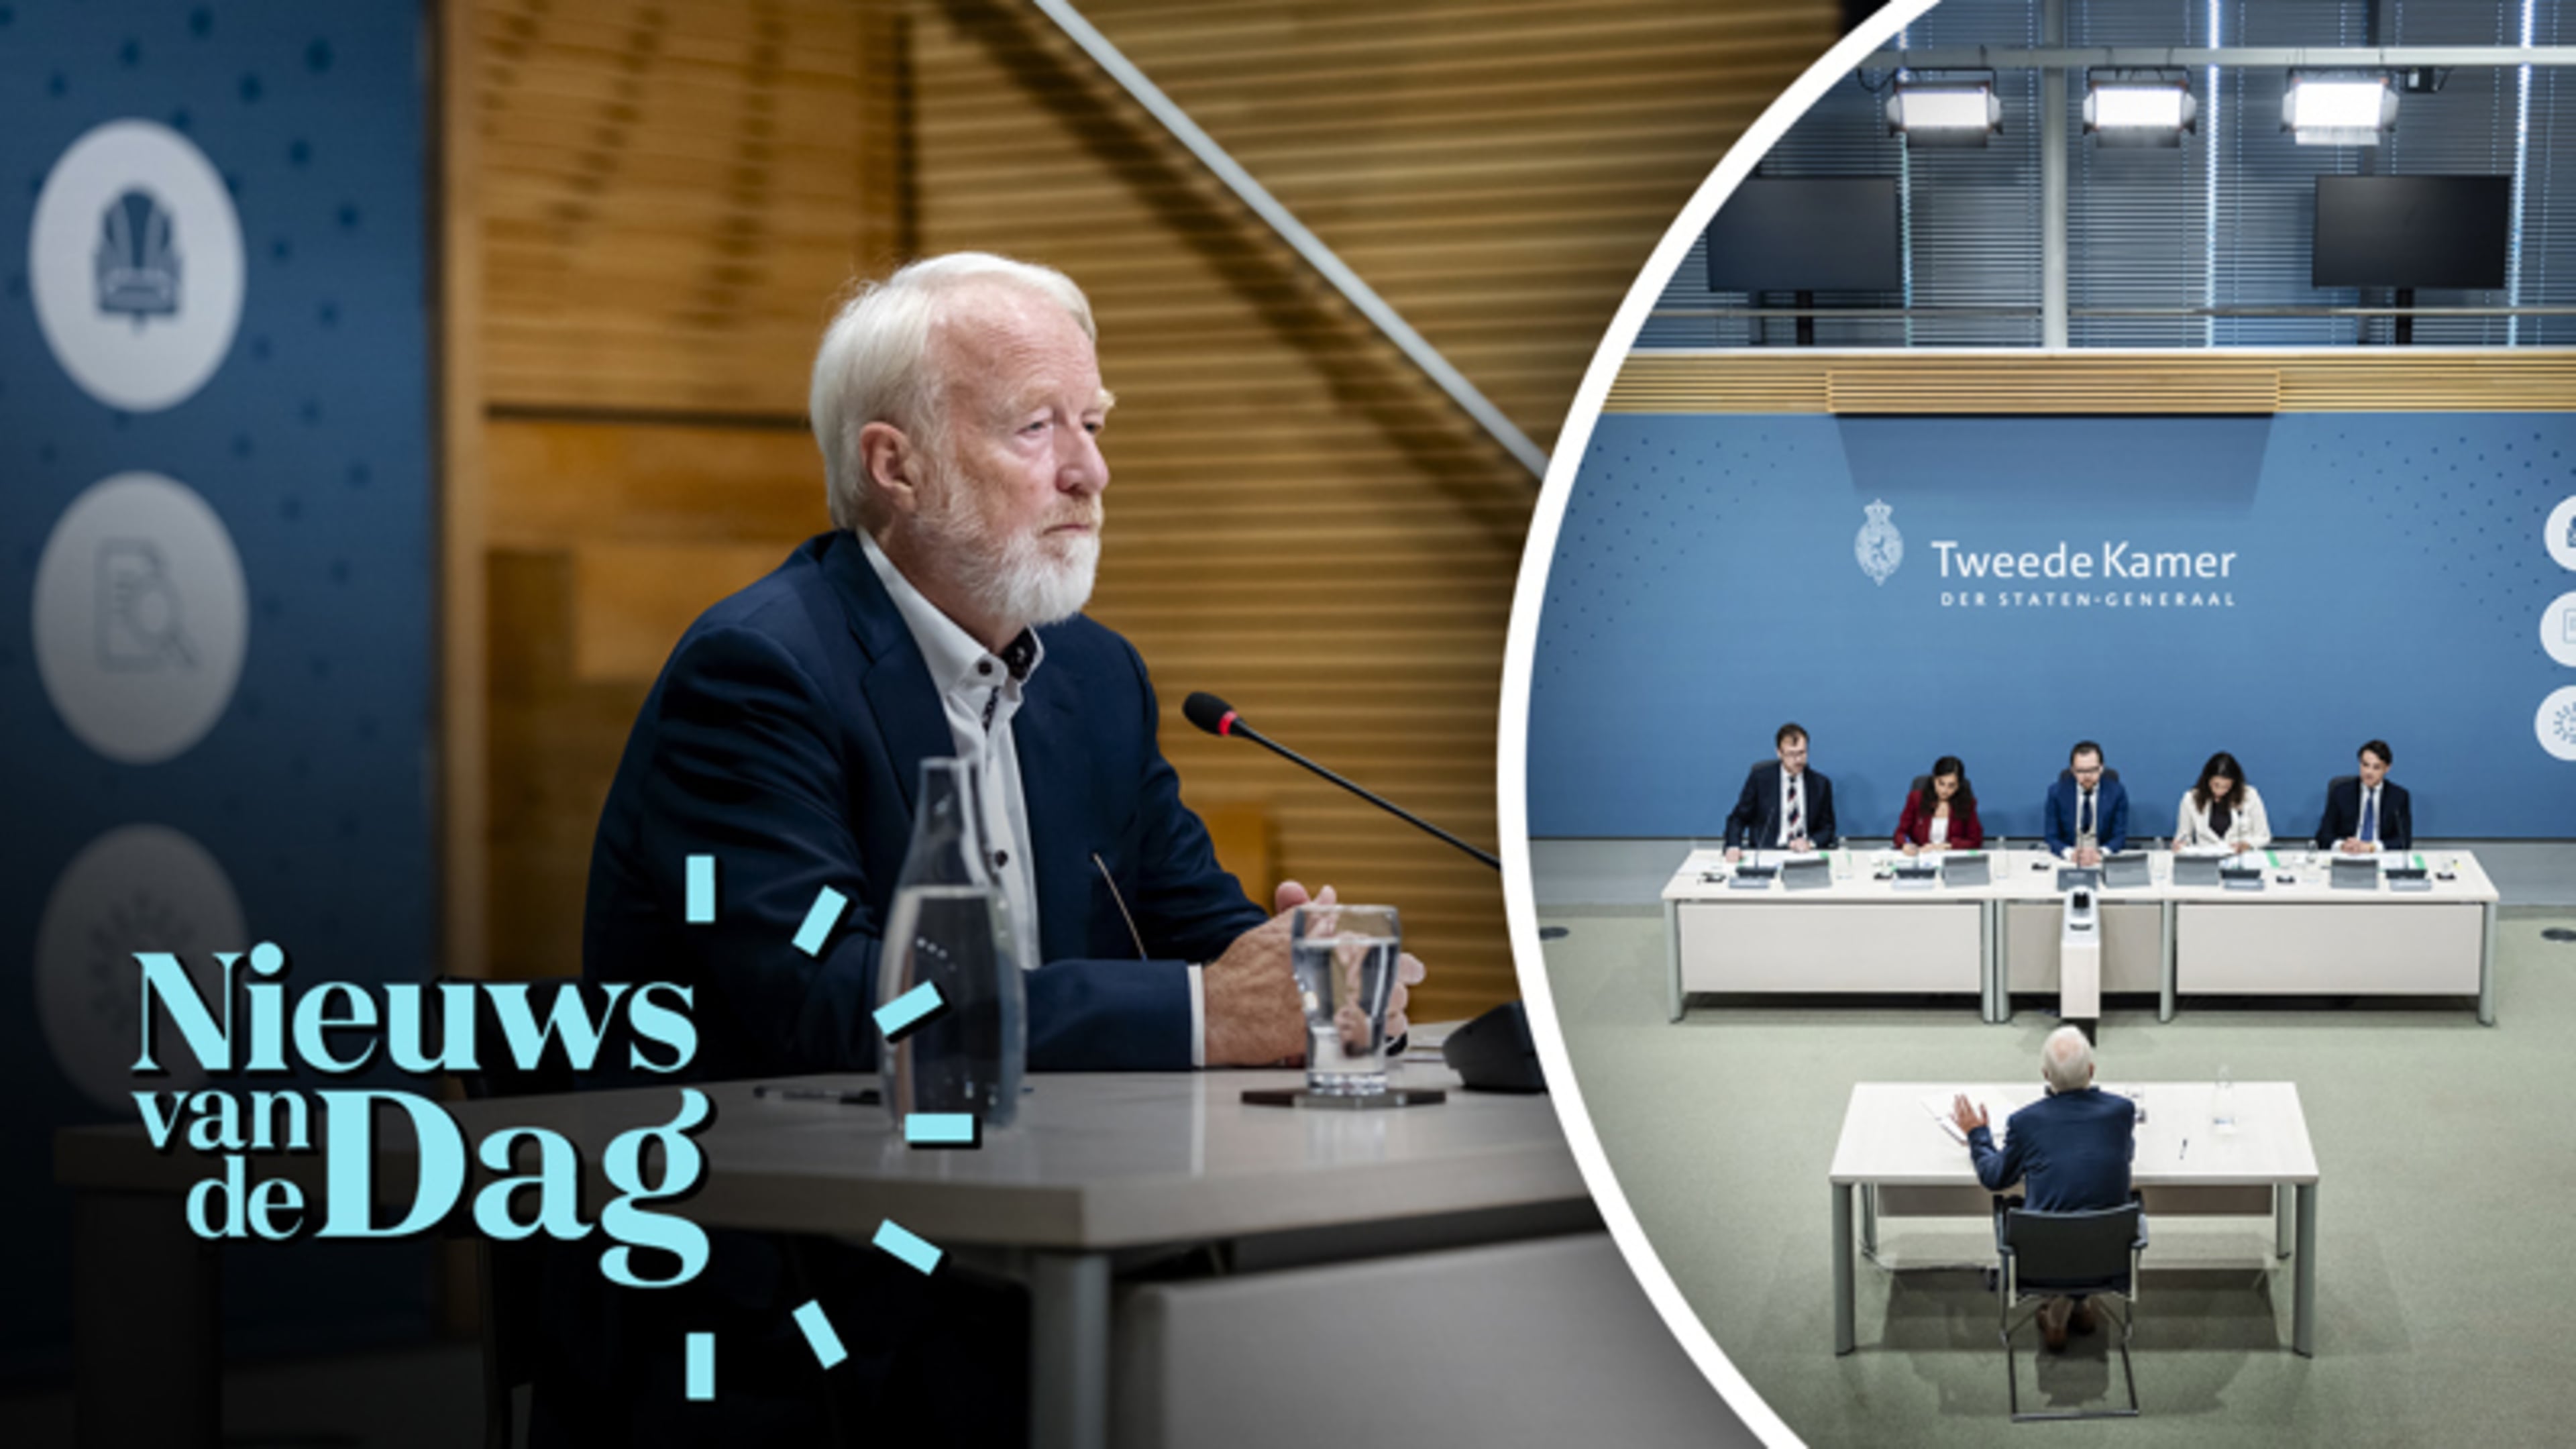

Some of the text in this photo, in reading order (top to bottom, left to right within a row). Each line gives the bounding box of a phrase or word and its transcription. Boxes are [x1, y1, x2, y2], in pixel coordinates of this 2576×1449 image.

[1931, 540, 2237, 578] Tweede Kamer
[1941, 592, 2235, 606] DER STATEN-GENERAAL
